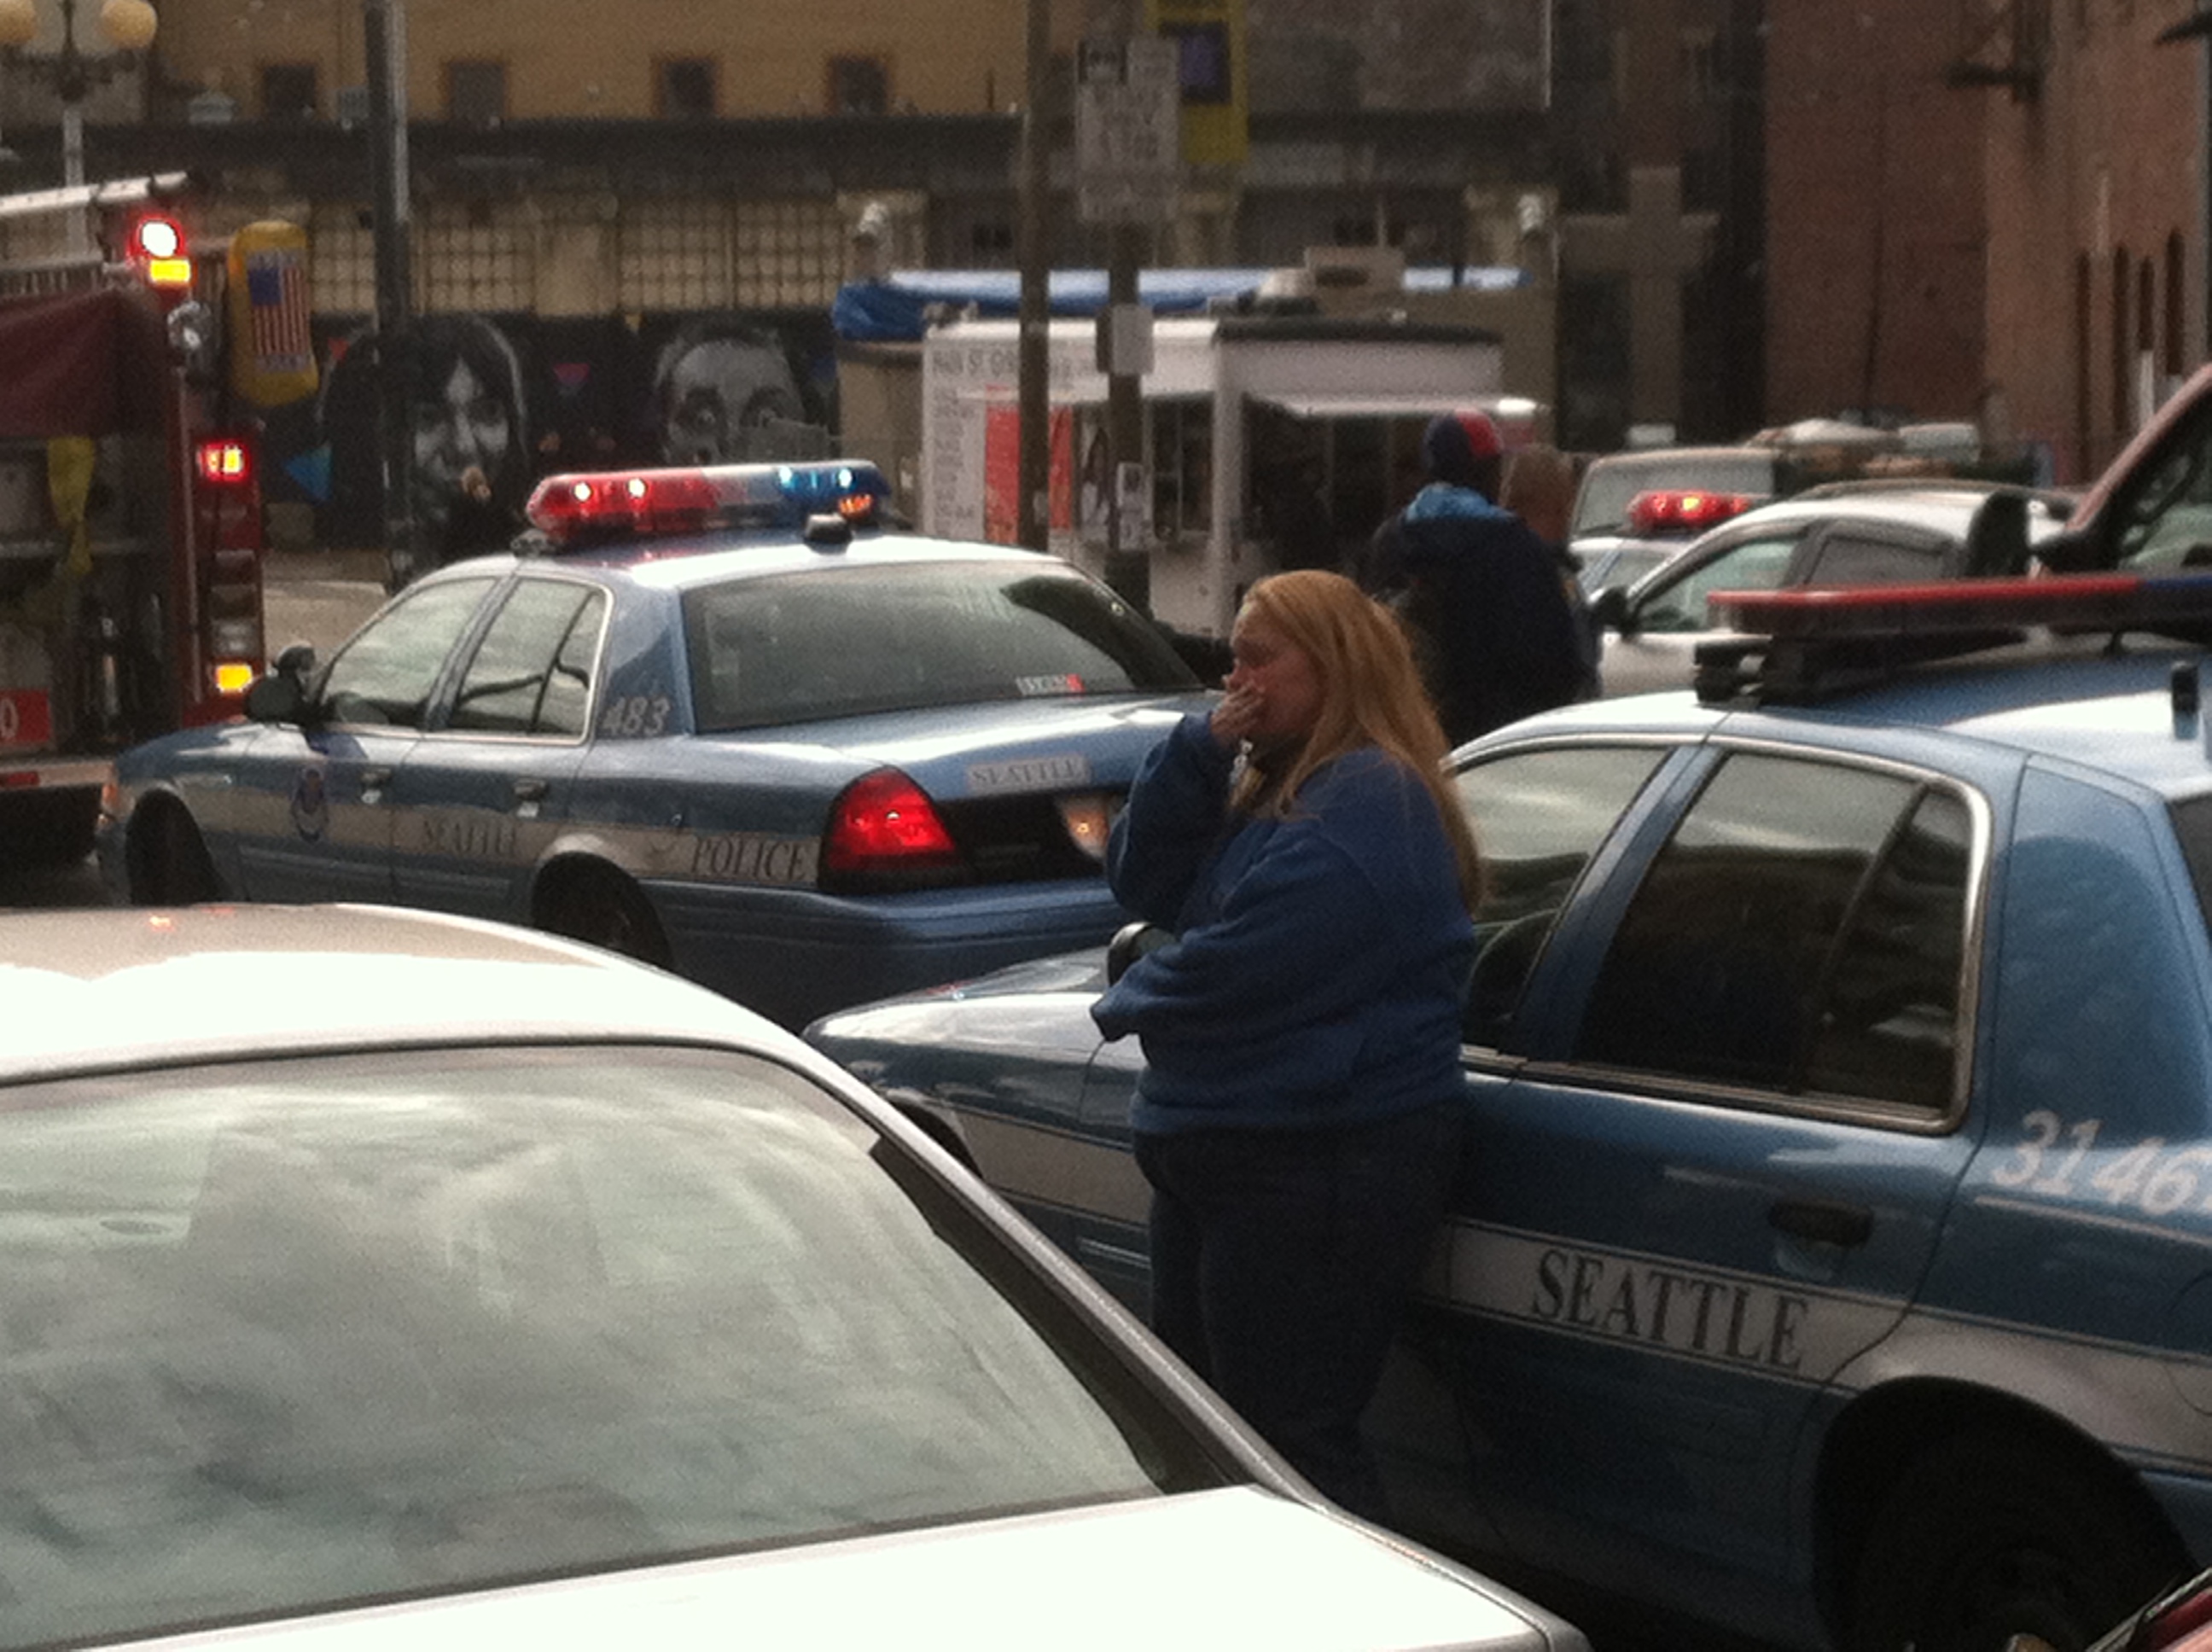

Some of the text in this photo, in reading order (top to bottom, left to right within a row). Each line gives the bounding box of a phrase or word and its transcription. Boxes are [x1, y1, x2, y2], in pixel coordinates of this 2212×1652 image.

[602, 695, 670, 736] 483
[692, 835, 812, 881] POLICE
[1992, 1109, 2212, 1216] 3146
[1532, 1248, 1807, 1370] SEATTLE
